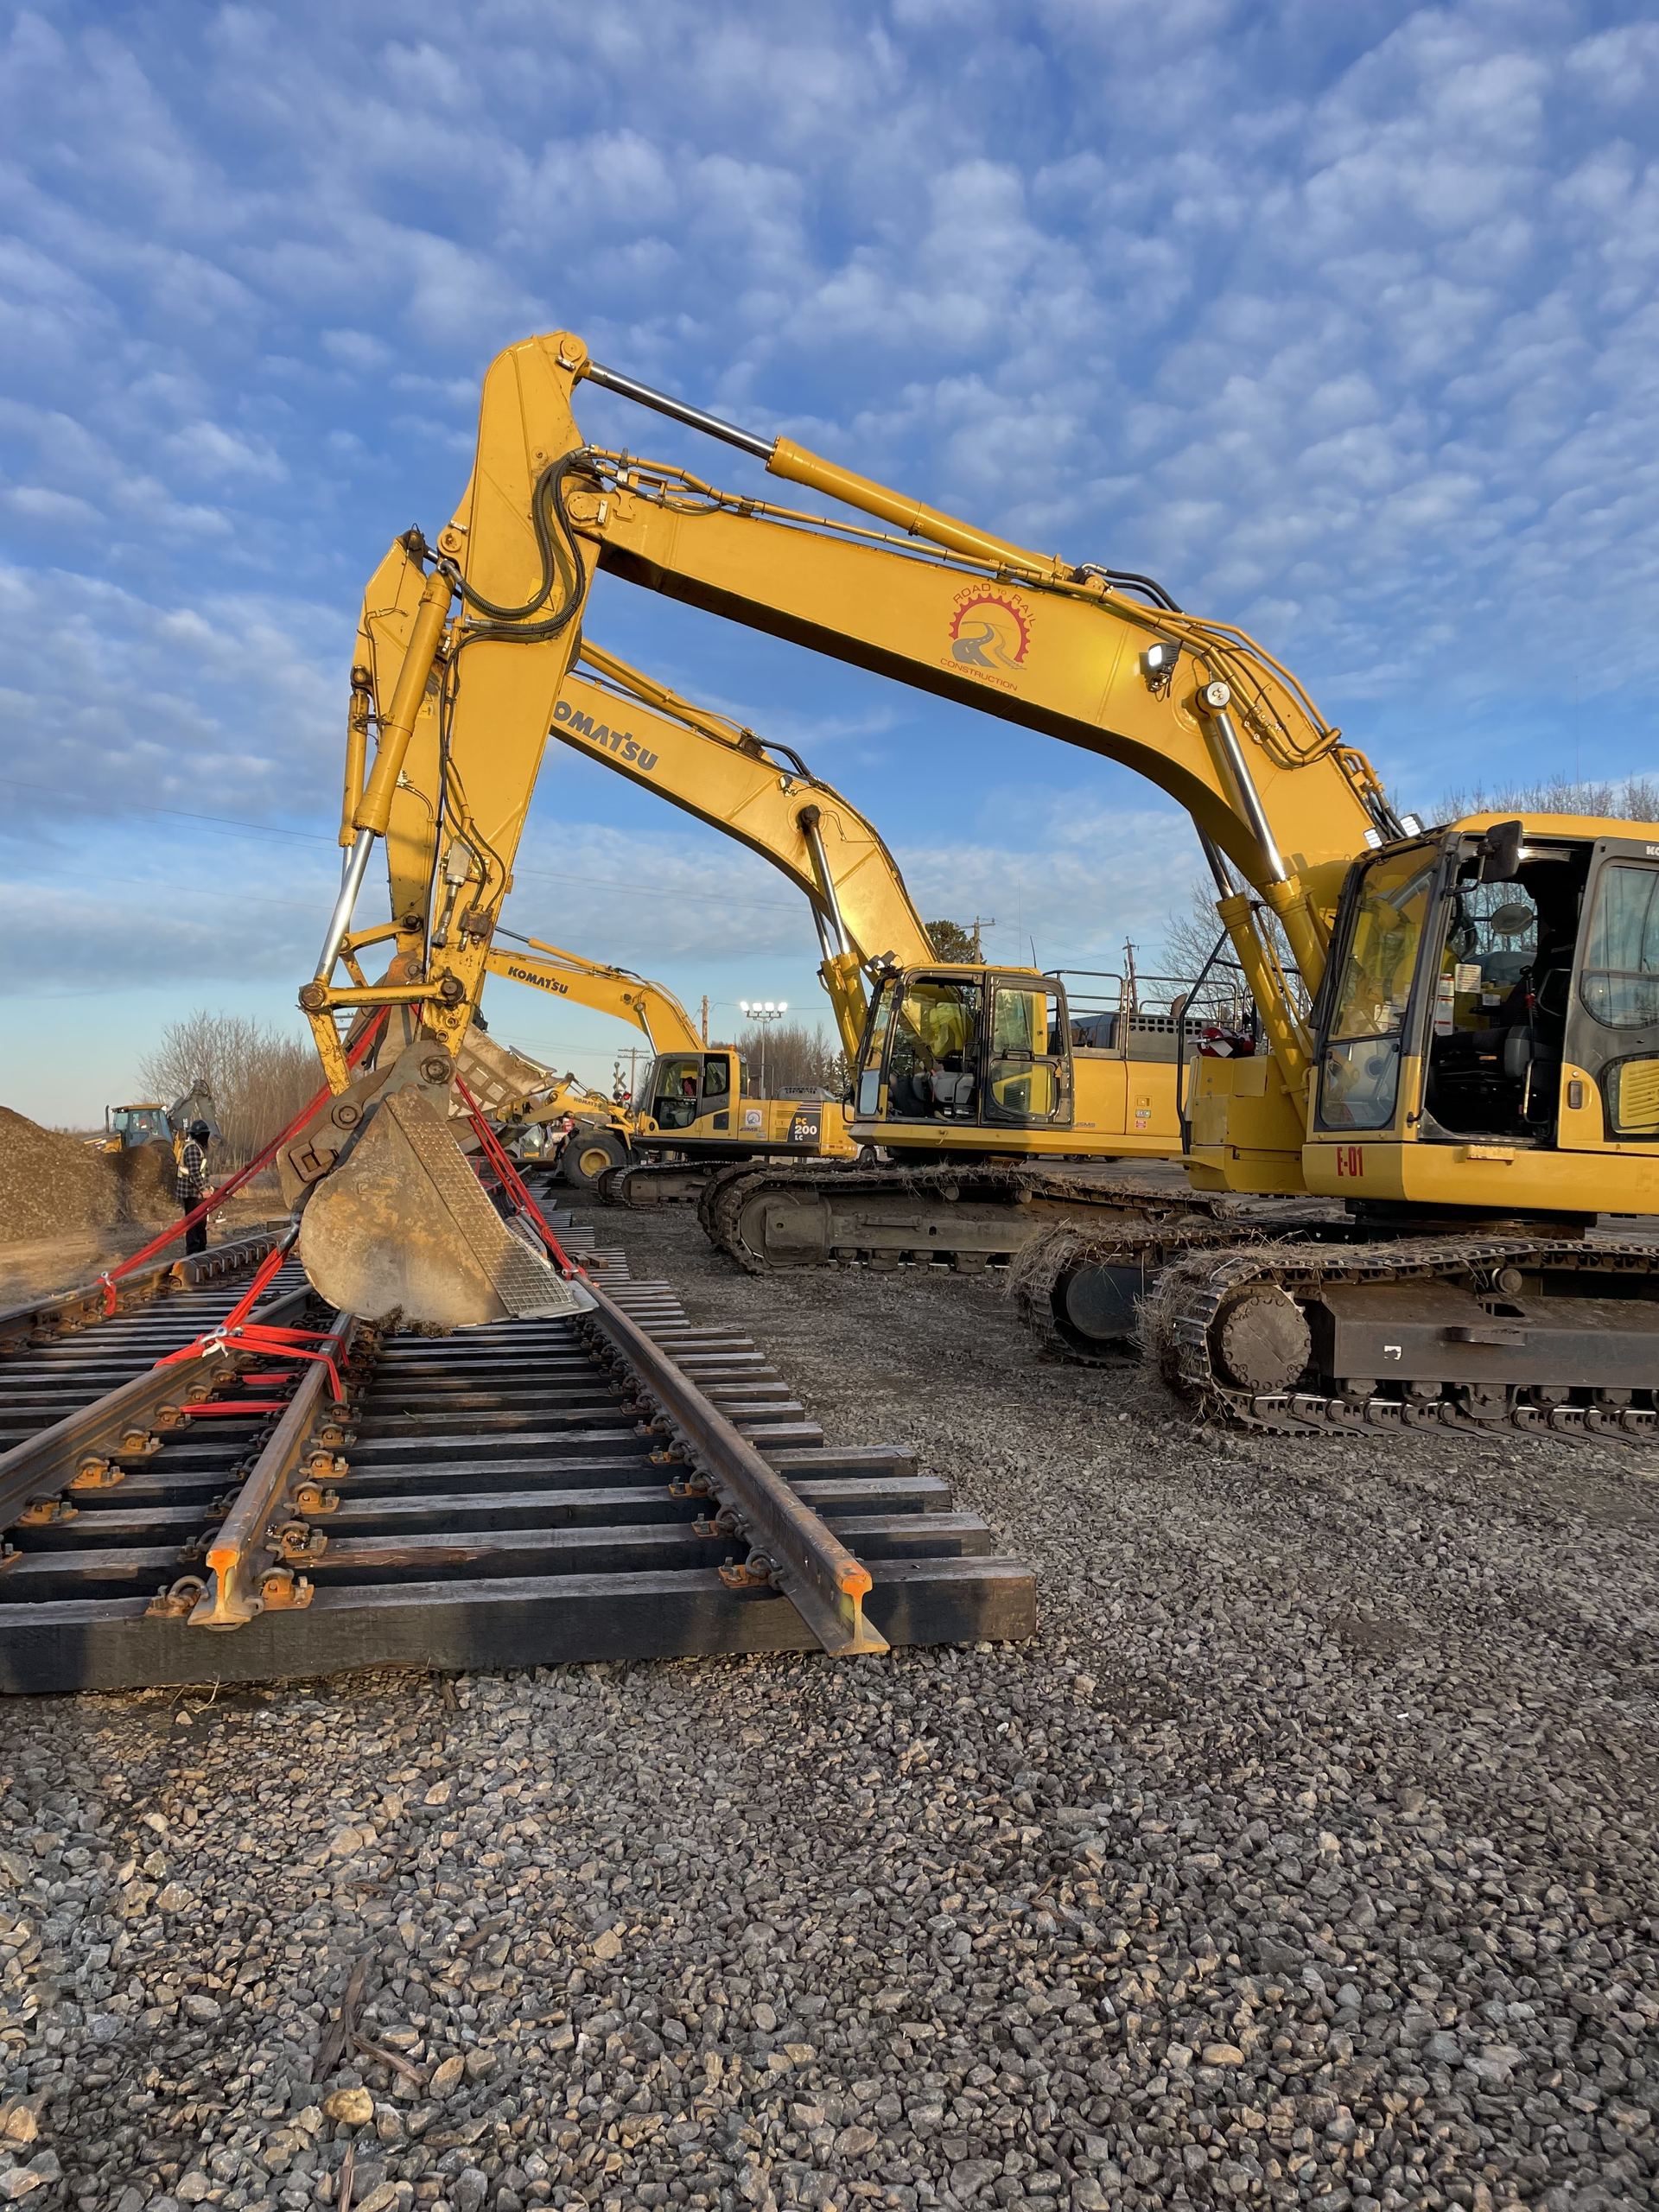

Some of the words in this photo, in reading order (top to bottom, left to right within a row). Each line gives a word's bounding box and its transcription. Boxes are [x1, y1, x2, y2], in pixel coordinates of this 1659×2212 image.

[953, 583, 990, 604] ROAD
[1012, 594, 1037, 627] RAIL
[940, 658, 1018, 691] CONSTRUCTION
[507, 966, 569, 994] KOMATSU
[794, 1125, 817, 1135] 200
[1337, 1147, 1363, 1176] E-01
